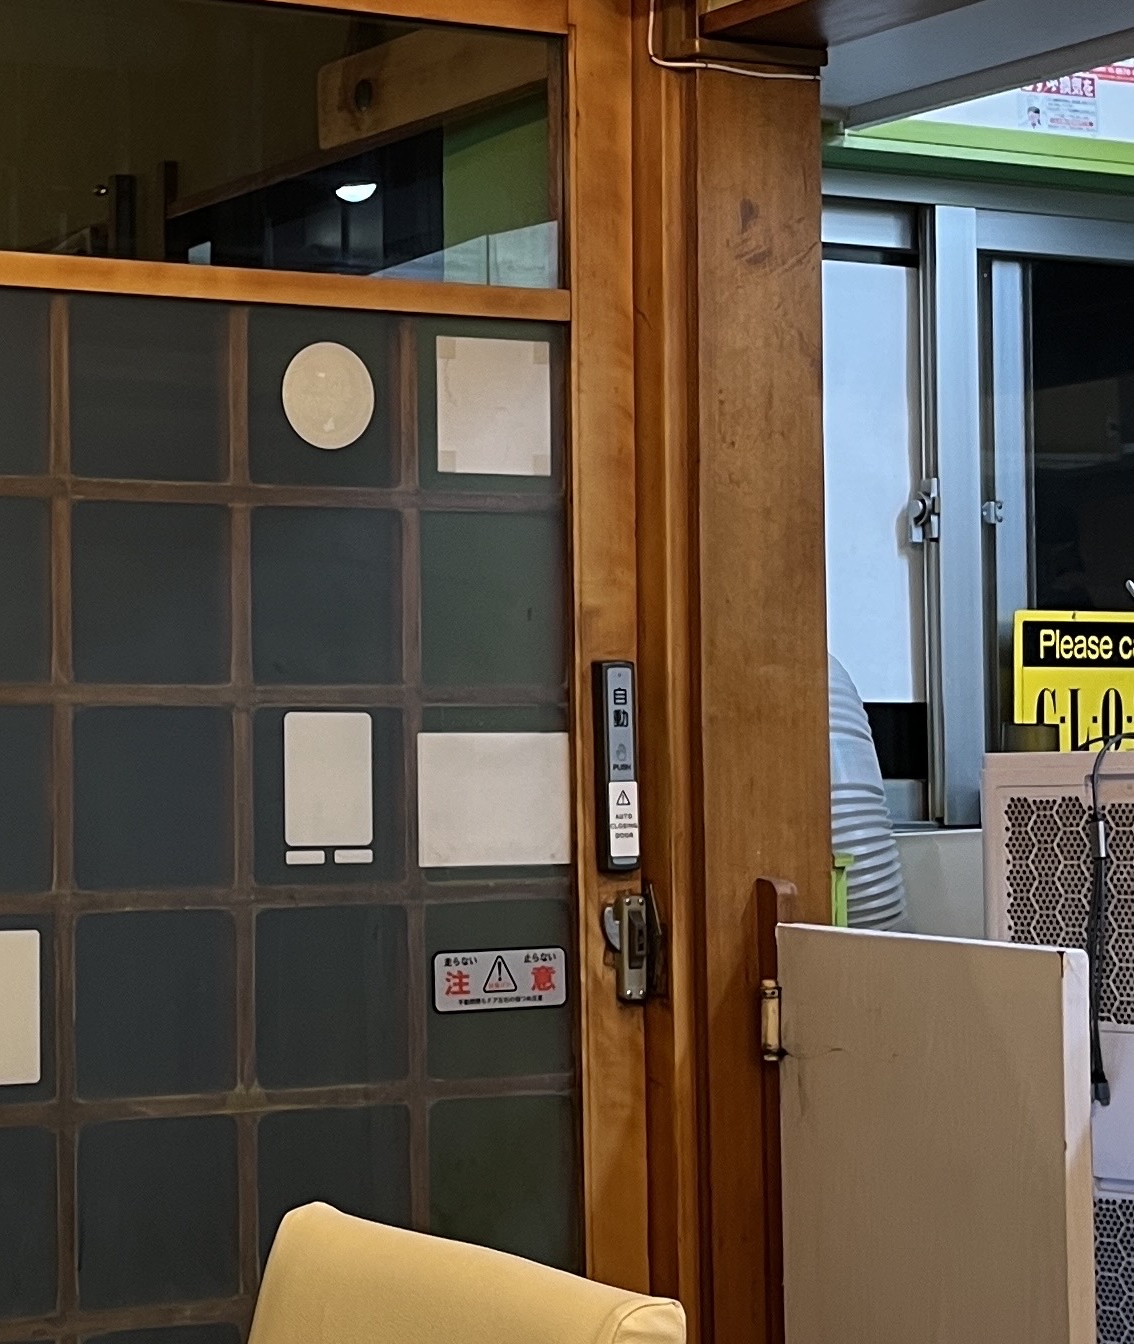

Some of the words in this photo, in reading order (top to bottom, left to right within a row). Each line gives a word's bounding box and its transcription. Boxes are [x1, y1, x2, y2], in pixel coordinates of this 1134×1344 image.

[1039, 628, 1113, 659] Please
[1119, 635, 1134, 659] c
[613, 687, 629, 728] 自動
